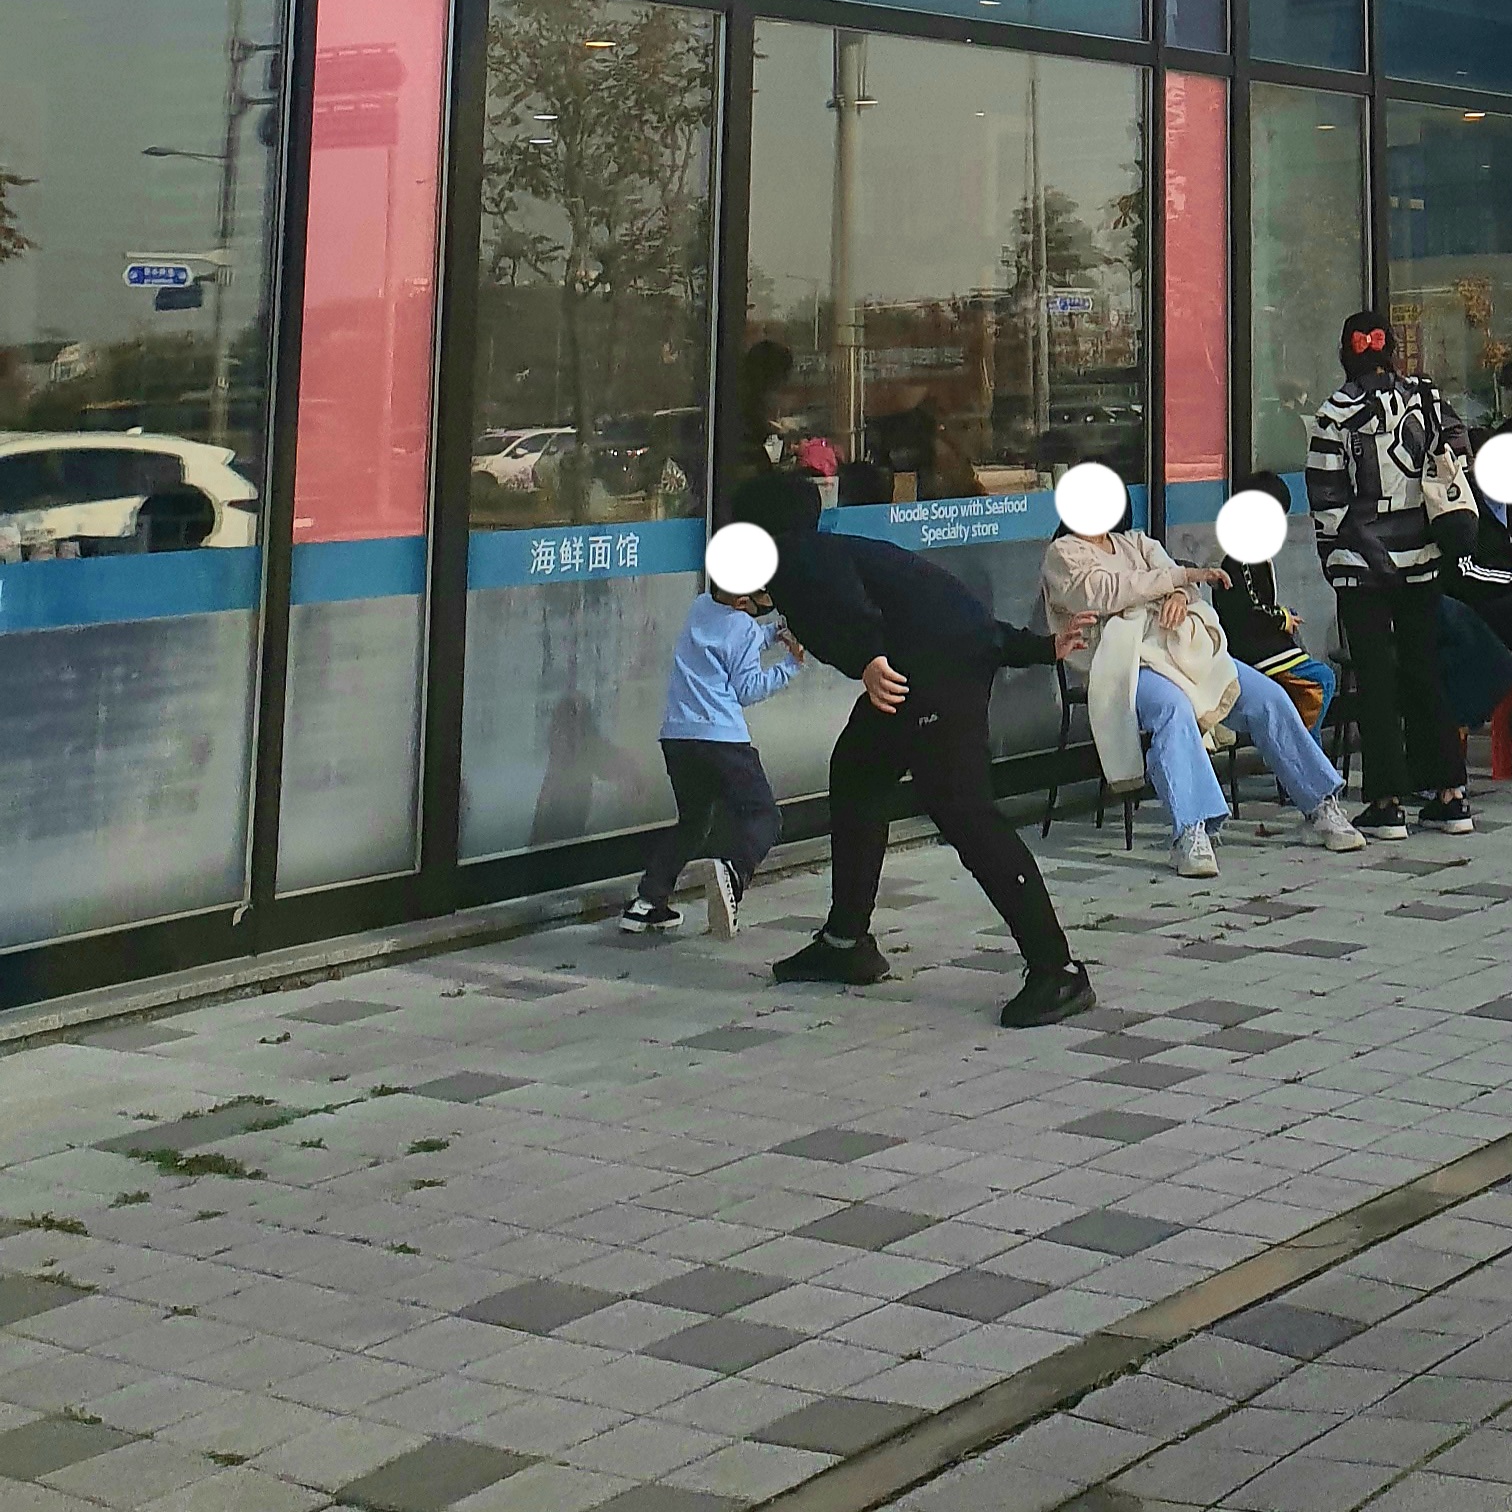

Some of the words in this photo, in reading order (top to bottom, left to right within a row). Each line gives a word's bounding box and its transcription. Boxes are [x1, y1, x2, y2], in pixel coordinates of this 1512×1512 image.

[890, 504, 929, 523] Noodle
[930, 502, 958, 523] Soup
[960, 499, 983, 517] with
[985, 496, 1027, 514] Seafood
[921, 522, 970, 547] Specialty
[971, 522, 999, 537] store
[530, 532, 640, 574] 海鲜面馆
